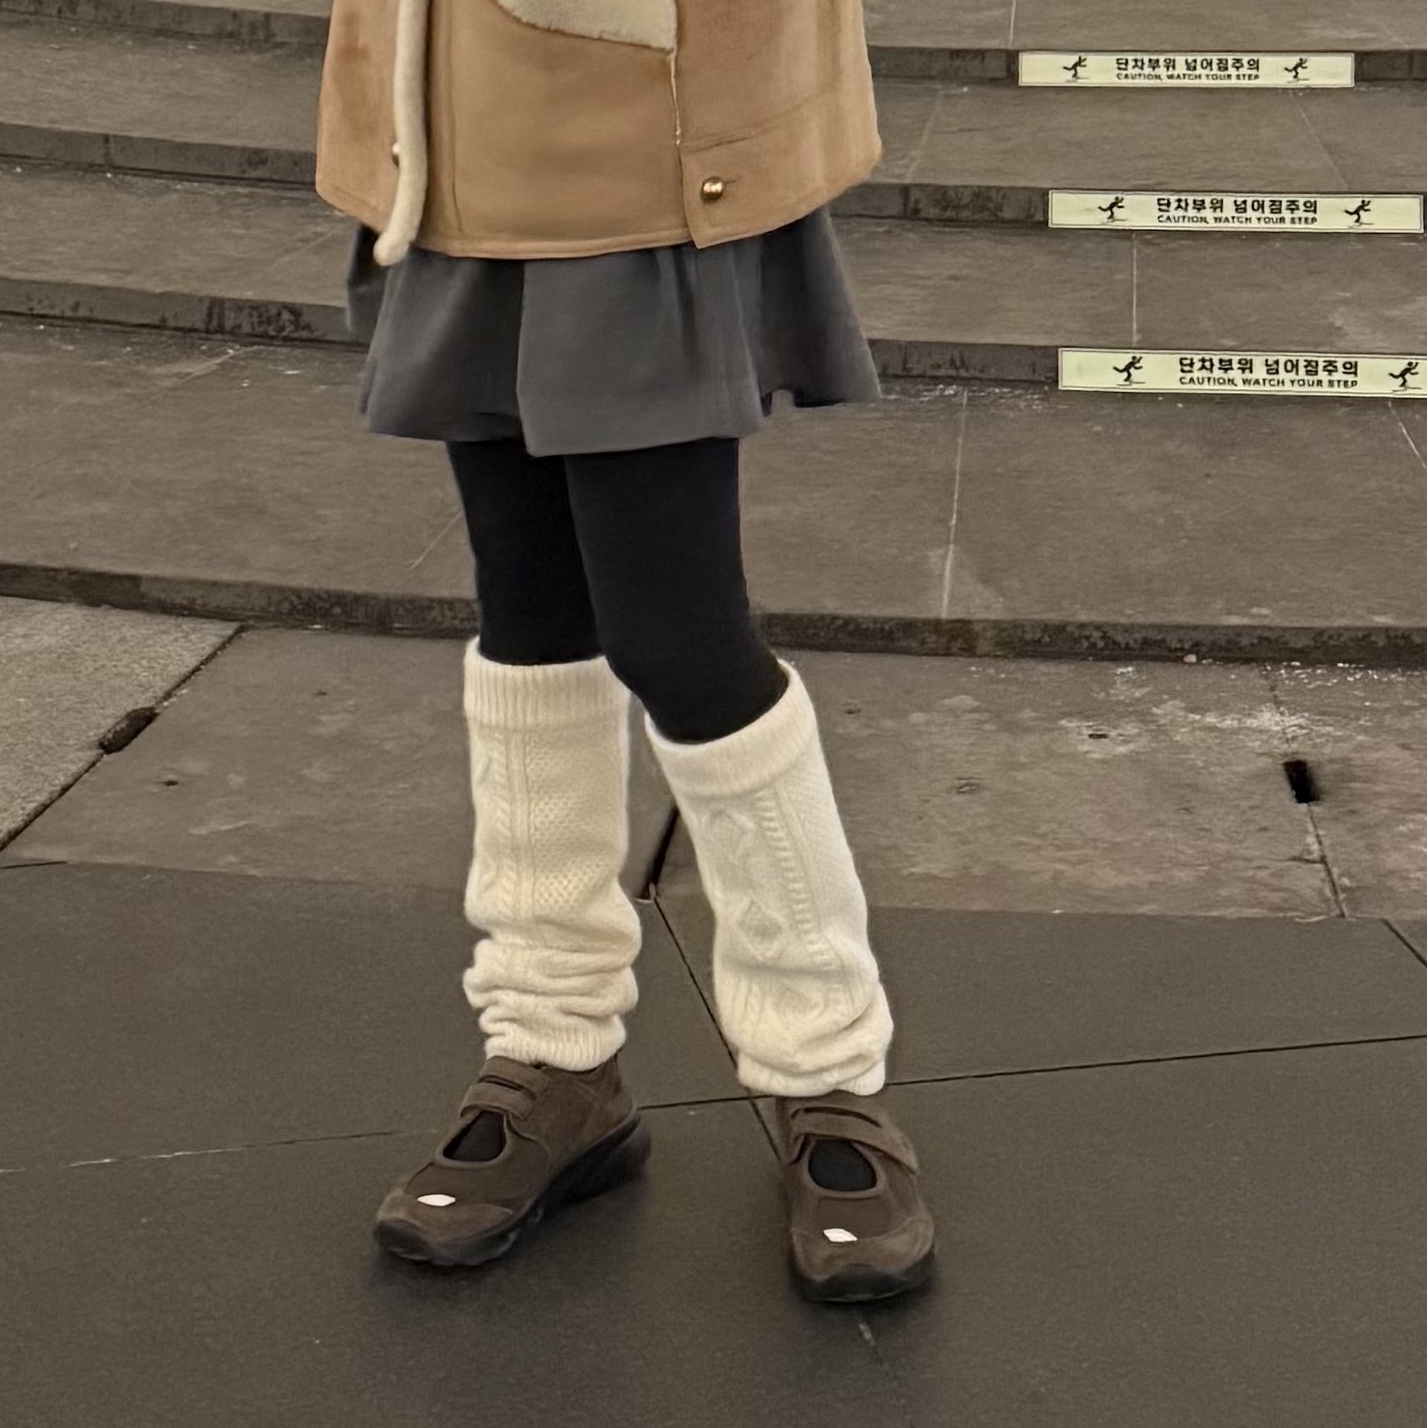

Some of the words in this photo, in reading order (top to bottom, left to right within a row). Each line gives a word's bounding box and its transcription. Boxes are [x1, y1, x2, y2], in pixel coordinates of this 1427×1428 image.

[1116, 58, 1176, 71] 단차부위
[1185, 58, 1260, 72] 넘어짐주의
[1116, 73, 1163, 81] CAUTION,
[1157, 197, 1224, 213] 단차부위
[1233, 199, 1318, 214] 넘어짐주의
[1157, 215, 1210, 224] CAUTION,
[1214, 216, 1252, 224] WATCH
[1256, 216, 1286, 224] YOUR
[1179, 357, 1254, 375] 단차부위
[1264, 358, 1359, 377] 넘어짐주의
[1179, 376, 1238, 387] CAUTION,
[1241, 378, 1286, 387] WATCH
[1290, 378, 1323, 387] YOUR
[1327, 379, 1359, 388] STEP
